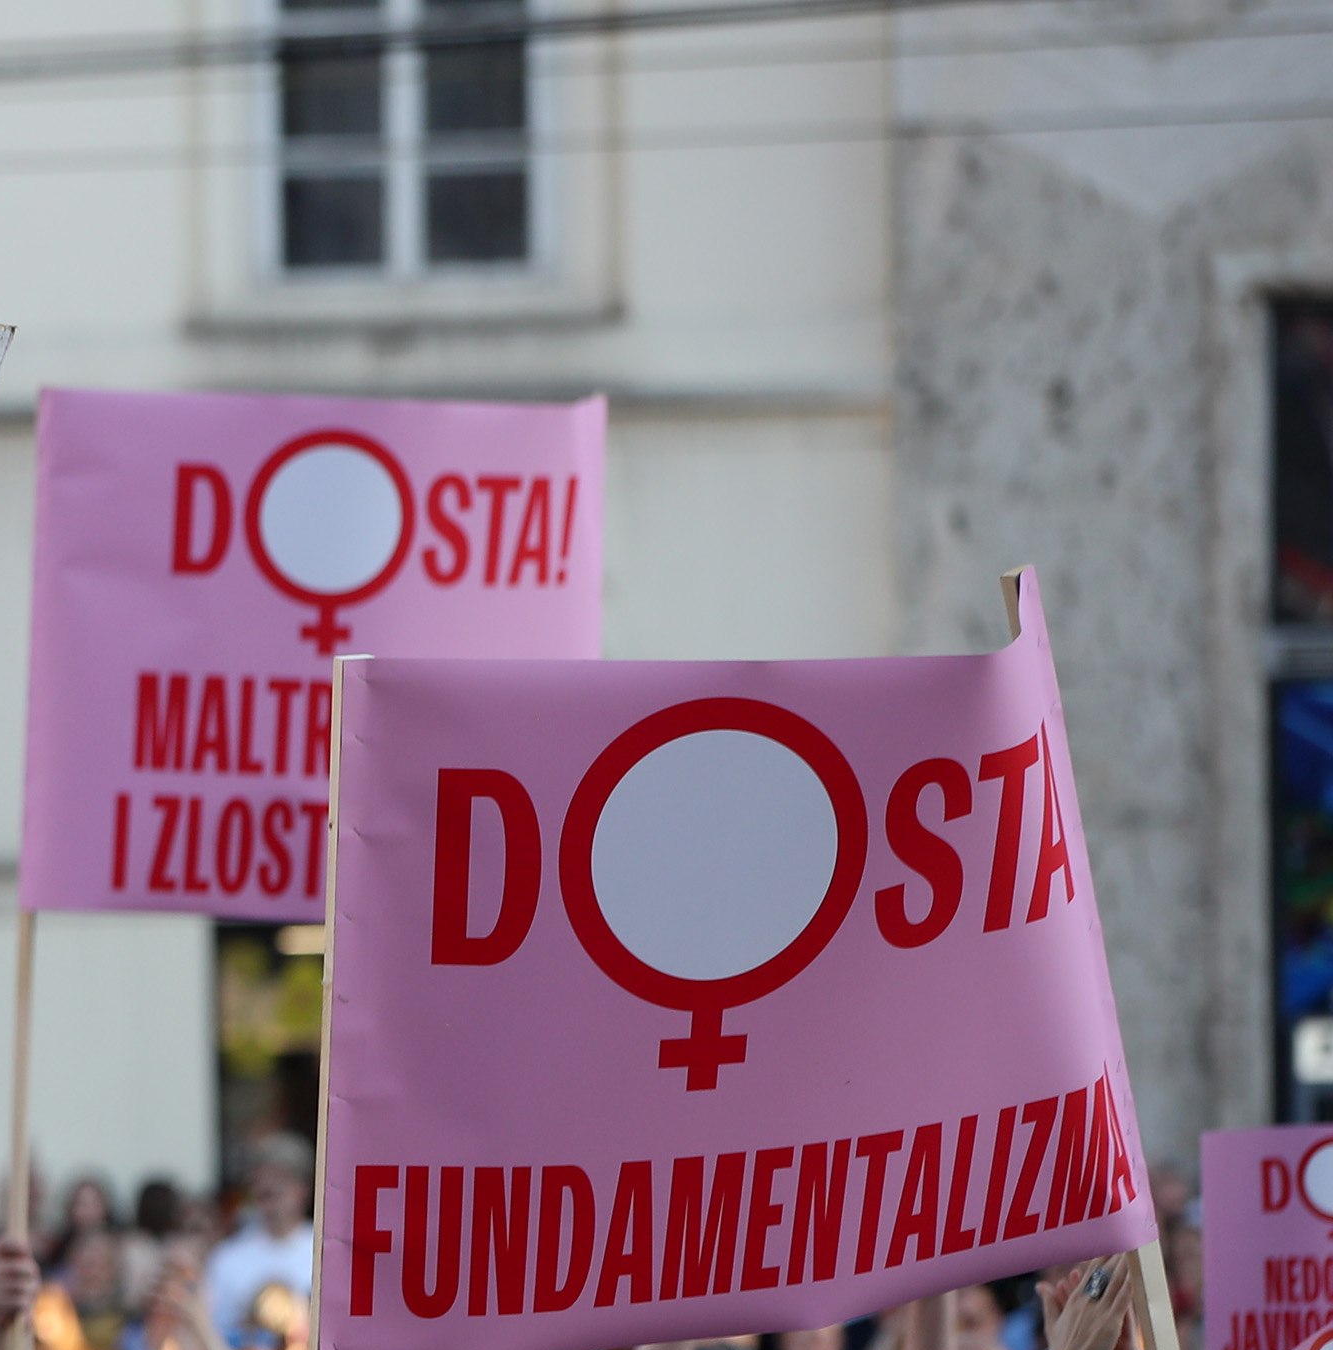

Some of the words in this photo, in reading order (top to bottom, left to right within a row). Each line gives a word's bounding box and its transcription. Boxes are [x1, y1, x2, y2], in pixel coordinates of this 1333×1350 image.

[171, 427, 579, 607] DOSTA!
[431, 697, 1076, 1010] DOSTA
[349, 1062, 1137, 1320] FUNDAMENTALIZMA
